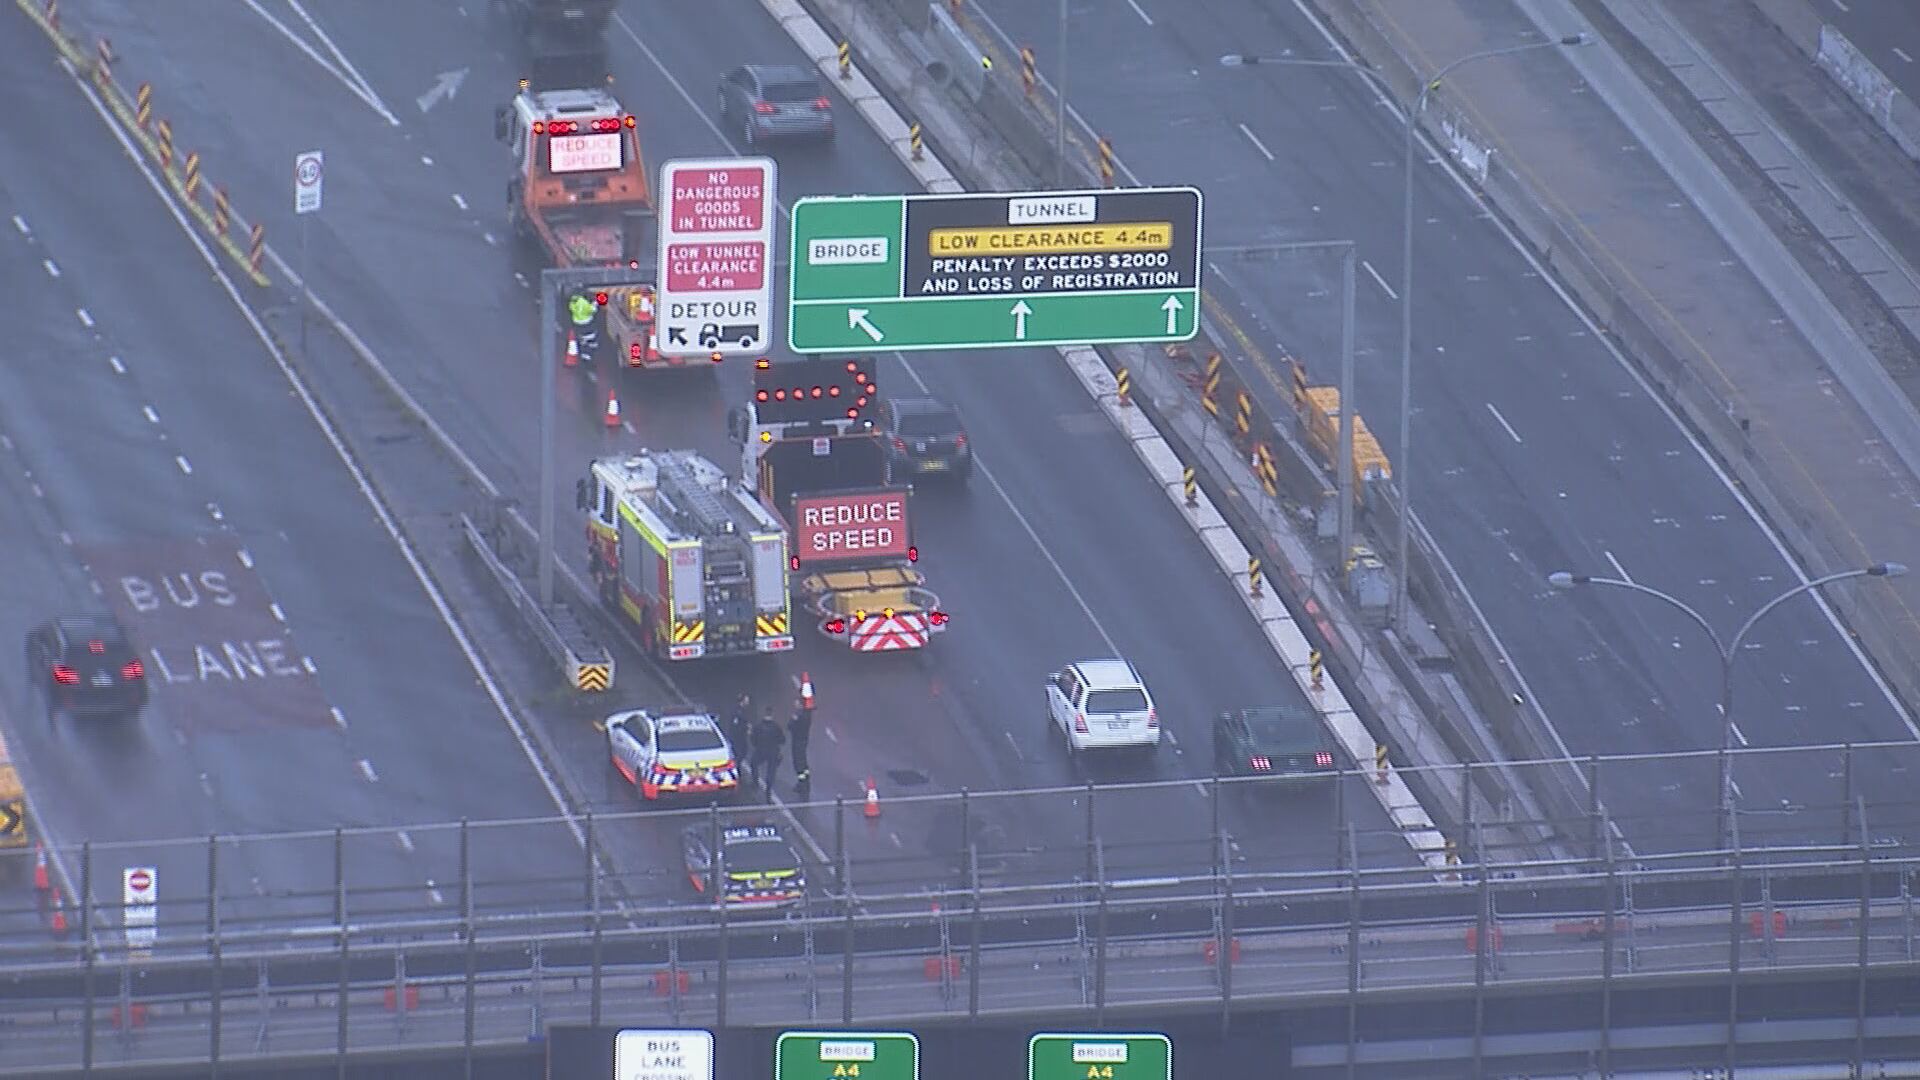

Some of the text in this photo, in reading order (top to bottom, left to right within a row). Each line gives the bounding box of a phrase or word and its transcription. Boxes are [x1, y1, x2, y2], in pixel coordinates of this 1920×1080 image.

[555, 139, 615, 153] REDUCE
[563, 153, 611, 166] SPEED
[708, 172, 729, 184] NO
[675, 185, 760, 200] DANGEROUS
[694, 201, 740, 215] GOODS
[1017, 203, 1089, 217] TUNNEL
[679, 215, 754, 230] IN TUNNEL
[940, 230, 1163, 250] LOW CLEARANCE 4.4m
[671, 245, 760, 260] LOW TUNNEL
[815, 244, 881, 259] BRIDGE
[673, 260, 758, 275] CLEARANCE
[932, 252, 1169, 273] PENALTY EXCEEDS $2000
[697, 276, 735, 289] 4.4m
[921, 271, 1179, 293] AND LOSS OF REGISTRATION
[671, 301, 757, 319] DETOUR
[804, 501, 901, 527] REDUCE
[812, 527, 892, 551] SPEED
[120, 569, 236, 612] BUS
[149, 639, 300, 682] LANE
[647, 1041, 680, 1052] BUS
[825, 1046, 869, 1056] BRIDGE
[1077, 1048, 1123, 1058] BRIDGE
[641, 1057, 686, 1069] LANE
[834, 1062, 860, 1077] A4
[1087, 1065, 1114, 1079] A4
